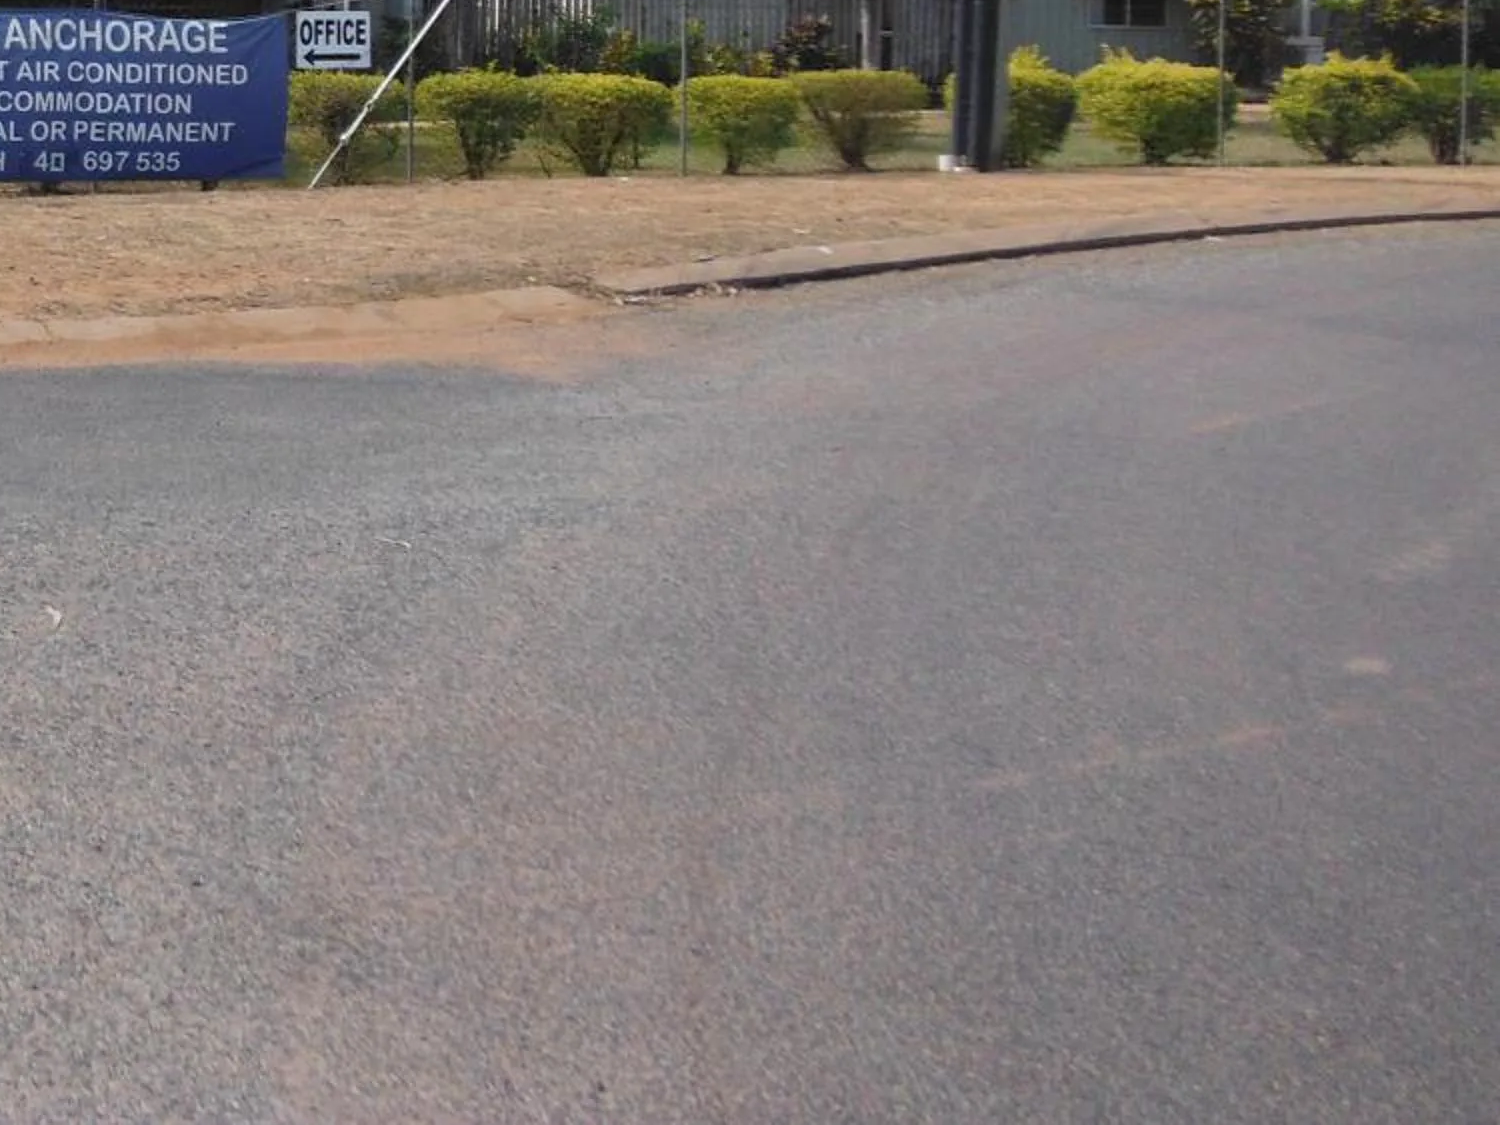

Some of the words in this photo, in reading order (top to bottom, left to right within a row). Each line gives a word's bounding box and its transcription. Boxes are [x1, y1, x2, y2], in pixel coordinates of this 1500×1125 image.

[3, 17, 229, 54] ANCHORAGE
[300, 19, 367, 46] OFFICE
[15, 60, 61, 83] AIR
[66, 60, 249, 86] CONDITIONED
[30, 119, 67, 142] OR
[72, 120, 236, 143] PERMANENT
[82, 150, 131, 172] 697
[134, 151, 182, 173] 535
